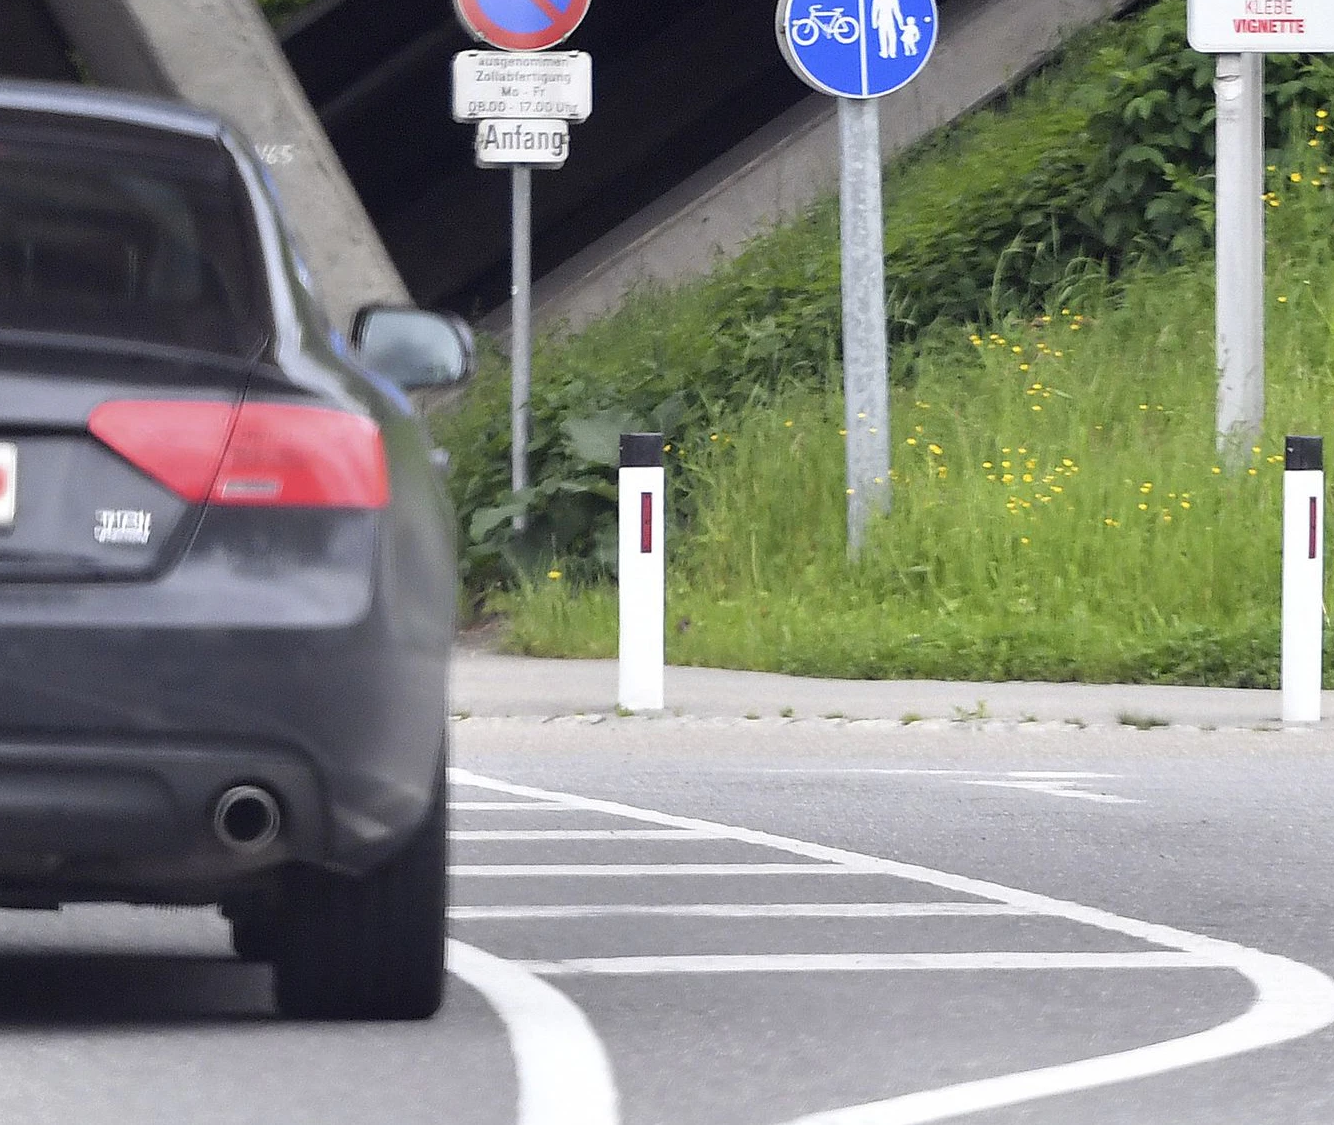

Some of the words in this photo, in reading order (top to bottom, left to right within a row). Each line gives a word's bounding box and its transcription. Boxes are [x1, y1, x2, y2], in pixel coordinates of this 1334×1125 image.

[1244, 0, 1293, 15] KLEBE
[1232, 18, 1305, 34] VIGNETTE
[478, 57, 569, 69] ausgenommen
[475, 70, 572, 85] Zollabfertigung
[501, 86, 519, 97] Mo
[533, 86, 545, 97] Fr
[483, 123, 564, 157] Anfang
